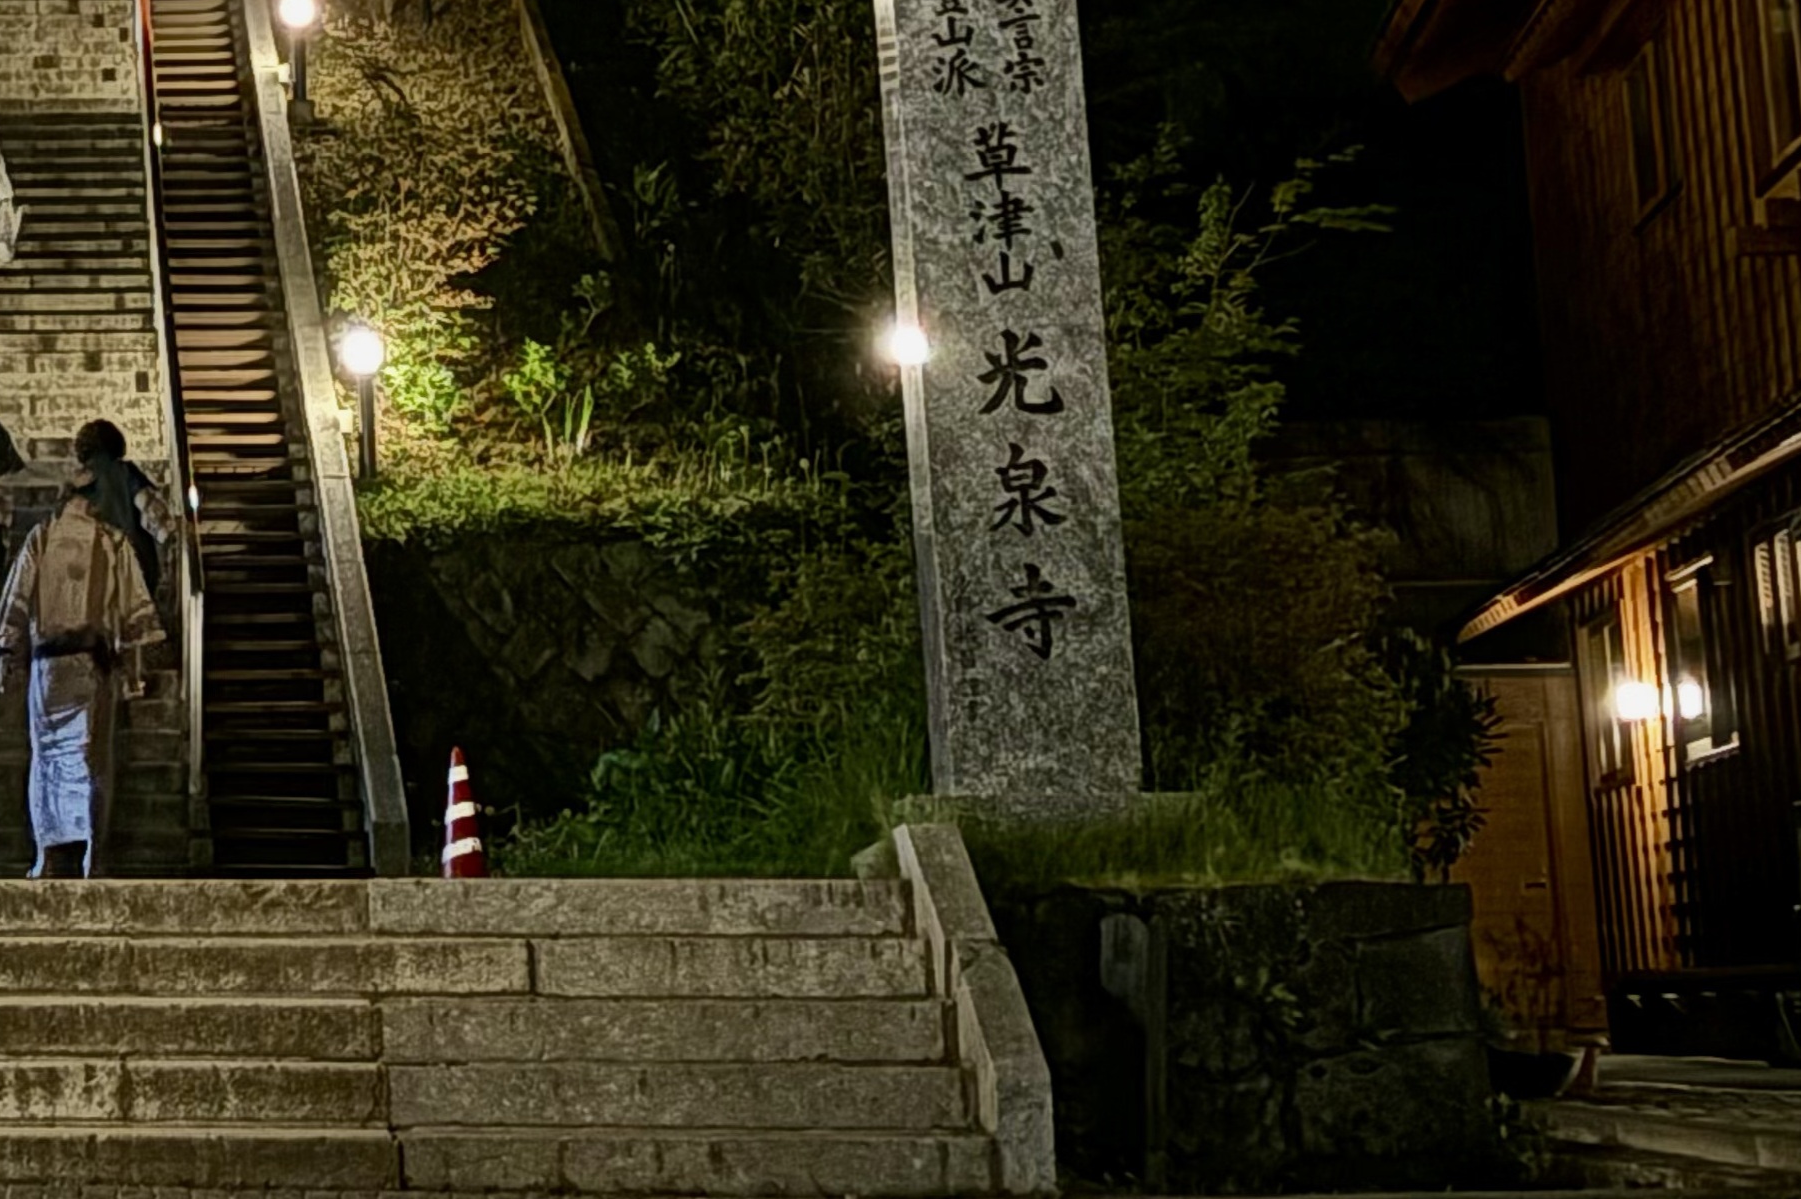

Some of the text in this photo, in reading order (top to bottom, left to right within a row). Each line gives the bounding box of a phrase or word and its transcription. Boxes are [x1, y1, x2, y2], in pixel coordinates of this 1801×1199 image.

[964, 120, 1078, 661] 草津山 光泉寺
